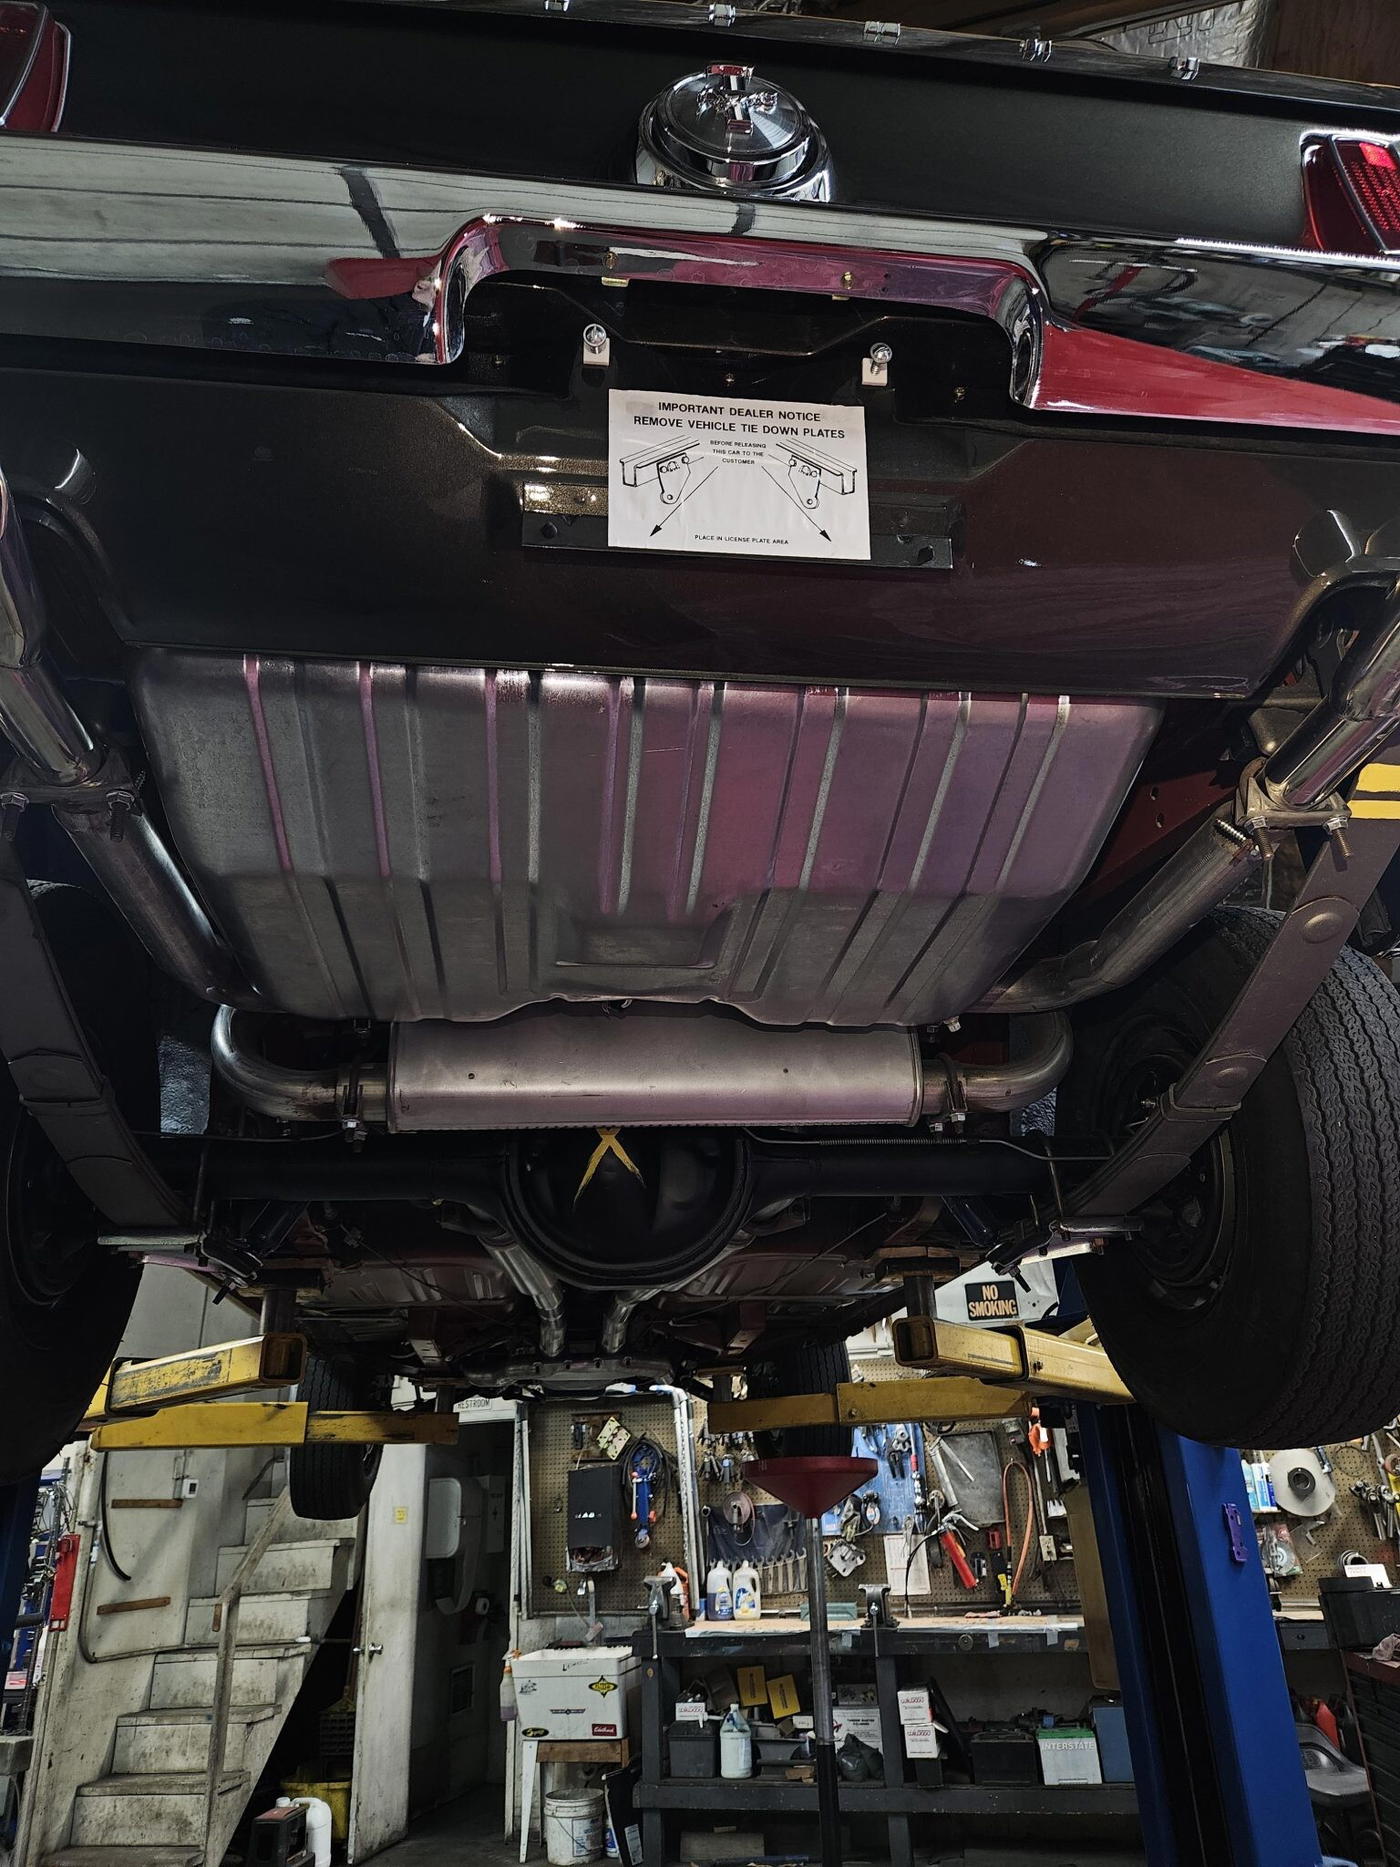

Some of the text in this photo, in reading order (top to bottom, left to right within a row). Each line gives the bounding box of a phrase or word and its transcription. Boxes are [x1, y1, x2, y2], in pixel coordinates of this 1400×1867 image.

[658, 402, 821, 421] IMPORTANT DEALER NOTICE
[633, 415, 845, 439] REMOVE VEHICLE TIE DOWN PLATES
[982, 1284, 998, 1300] NO
[968, 1300, 1017, 1317] SMOKING
[1041, 1741, 1095, 1751] INTERSTATE
